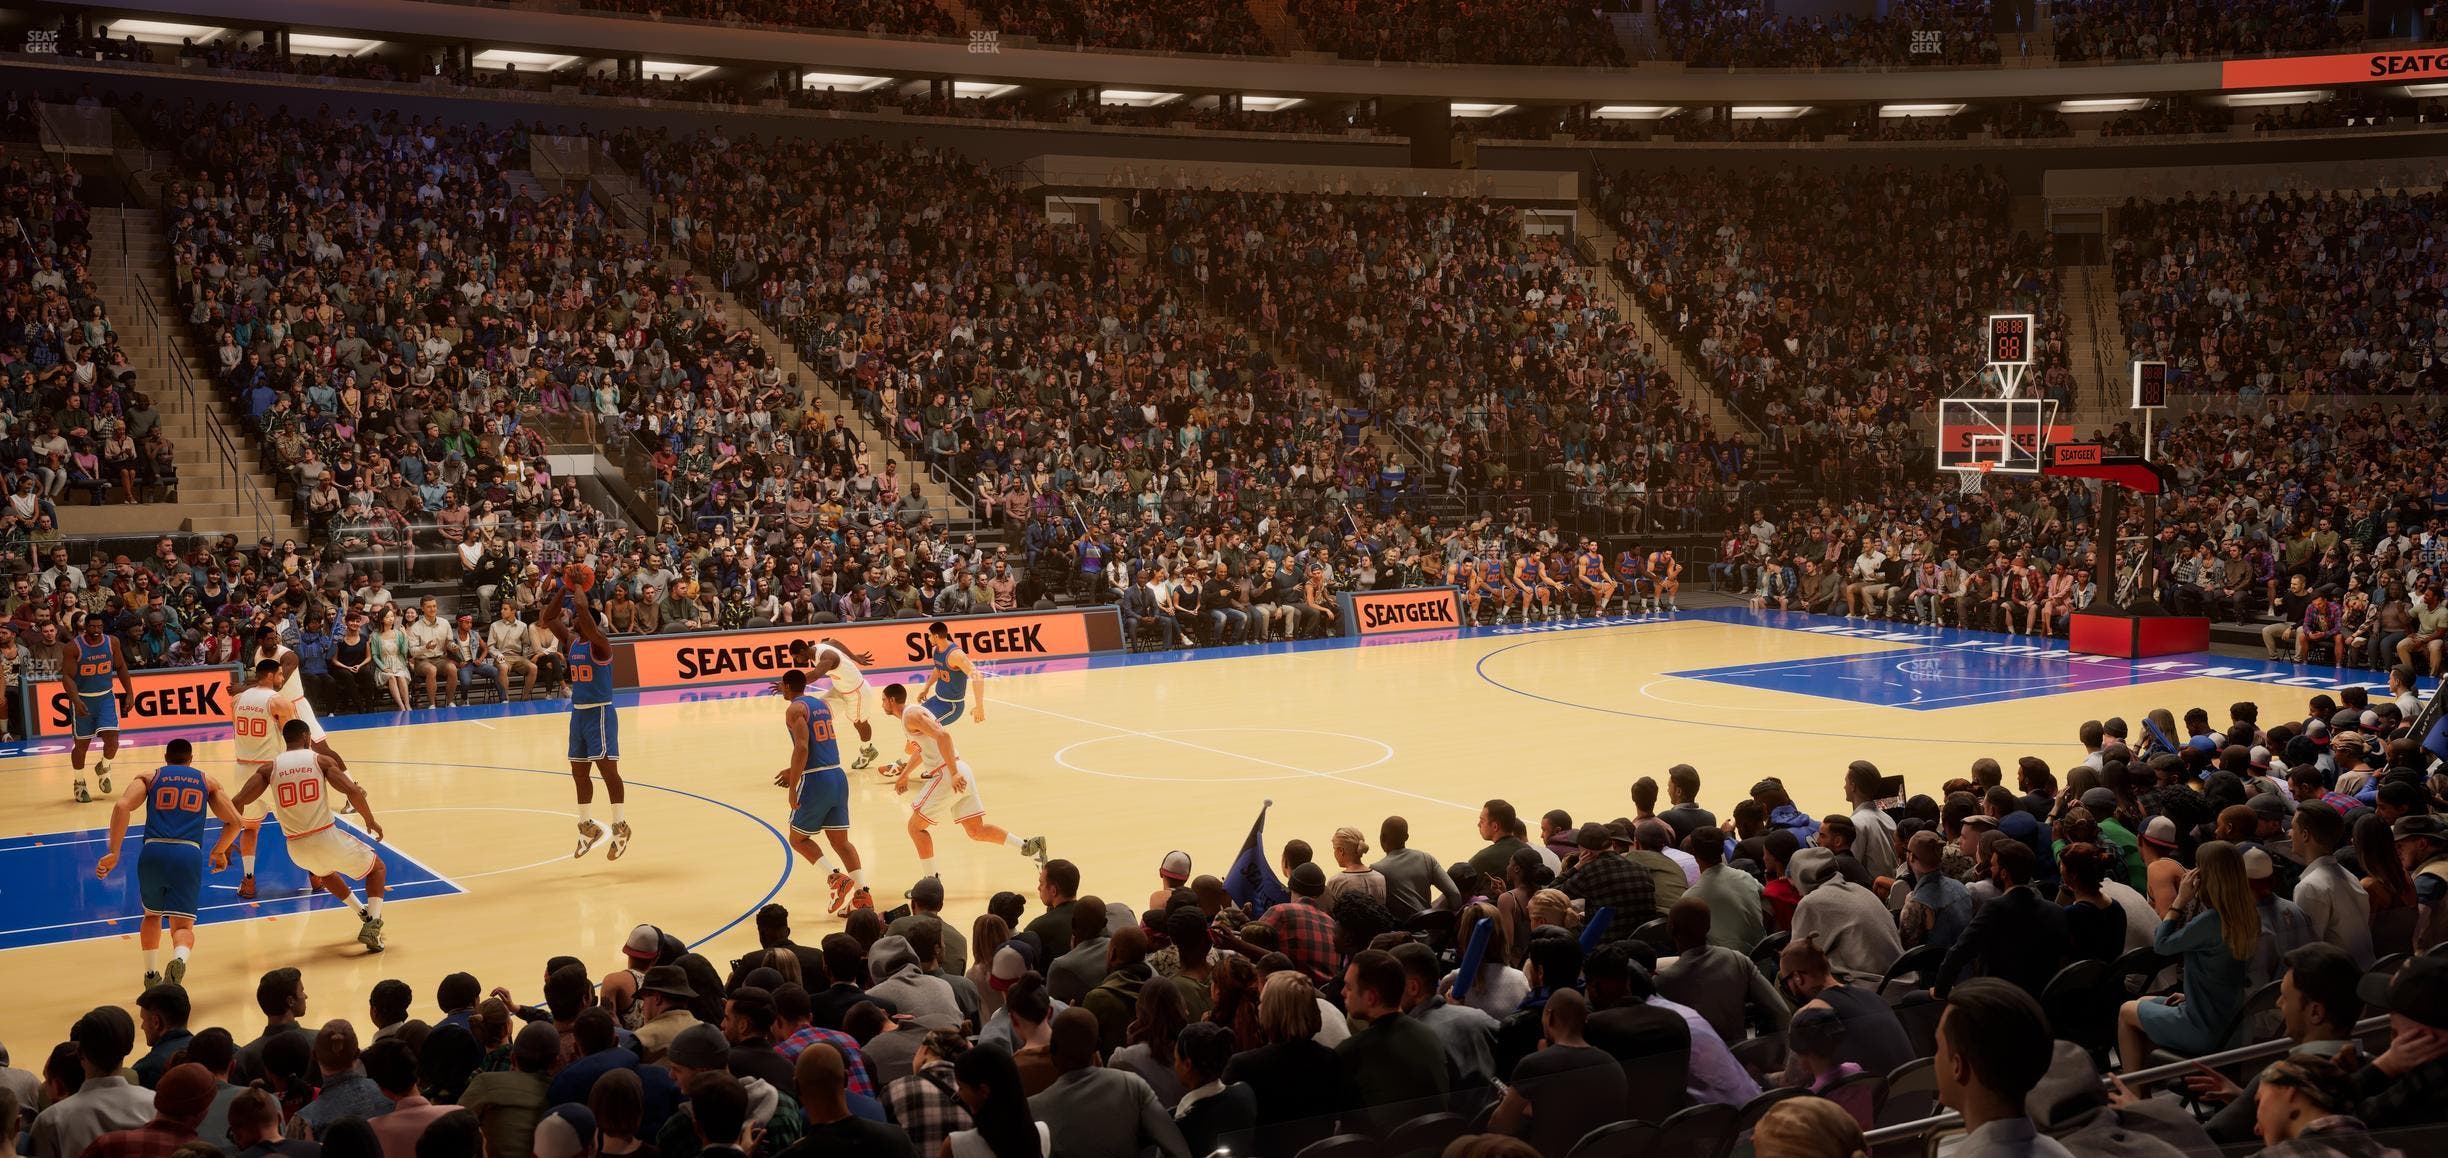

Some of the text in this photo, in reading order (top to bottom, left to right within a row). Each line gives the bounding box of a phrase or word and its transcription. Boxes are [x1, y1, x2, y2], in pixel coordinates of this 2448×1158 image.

[1999, 336, 2019, 359] 88
[2061, 449, 2096, 462] SEATGEEK
[1364, 598, 1454, 628] SEATGEEK
[906, 624, 1047, 662] STGEEK
[1793, 625, 1943, 641] NEW
[80, 660, 112, 676] 00
[87, 654, 107, 662] TEAM
[677, 638, 830, 680] SEATGE
[52, 681, 226, 727] STGEEK
[238, 704, 265, 714] PLAYER
[236, 716, 268, 738] 00
[161, 775, 197, 785] PLAYER
[278, 767, 314, 778] PLAYER
[156, 786, 204, 814] 00
[277, 778, 320, 808] 00
